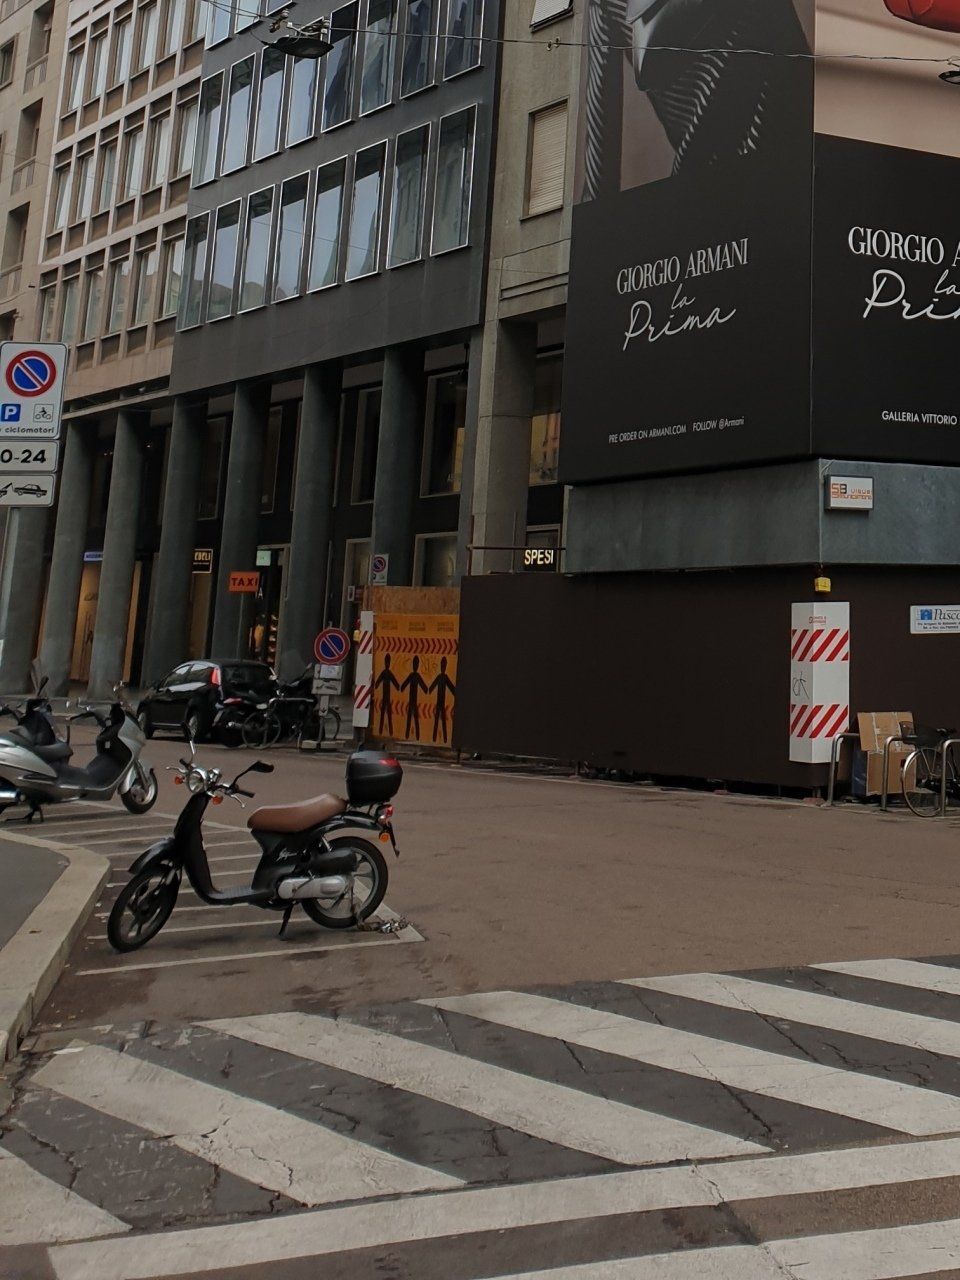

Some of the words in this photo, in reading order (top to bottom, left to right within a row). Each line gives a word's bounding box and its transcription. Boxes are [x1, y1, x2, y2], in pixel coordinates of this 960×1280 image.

[848, 226, 945, 265] GIORGIO
[616, 255, 681, 295] GIORGIO
[684, 237, 749, 279] ARMANI
[671, 283, 696, 310] la
[622, 300, 737, 351] Prima
[692, 419, 718, 432] FOLLOW
[881, 410, 920, 423] GALLERIA
[921, 413, 958, 425] VITTORIO
[5, 426, 54, 434] ciclomotori
[608, 433, 618, 444] PRE
[619, 431, 638, 442] ORDER
[638, 429, 648, 440] ON
[648, 424, 687, 438] ARMANI.COM
[0, 449, 47, 464] 0-24
[231, 577, 258, 587] TAXI
